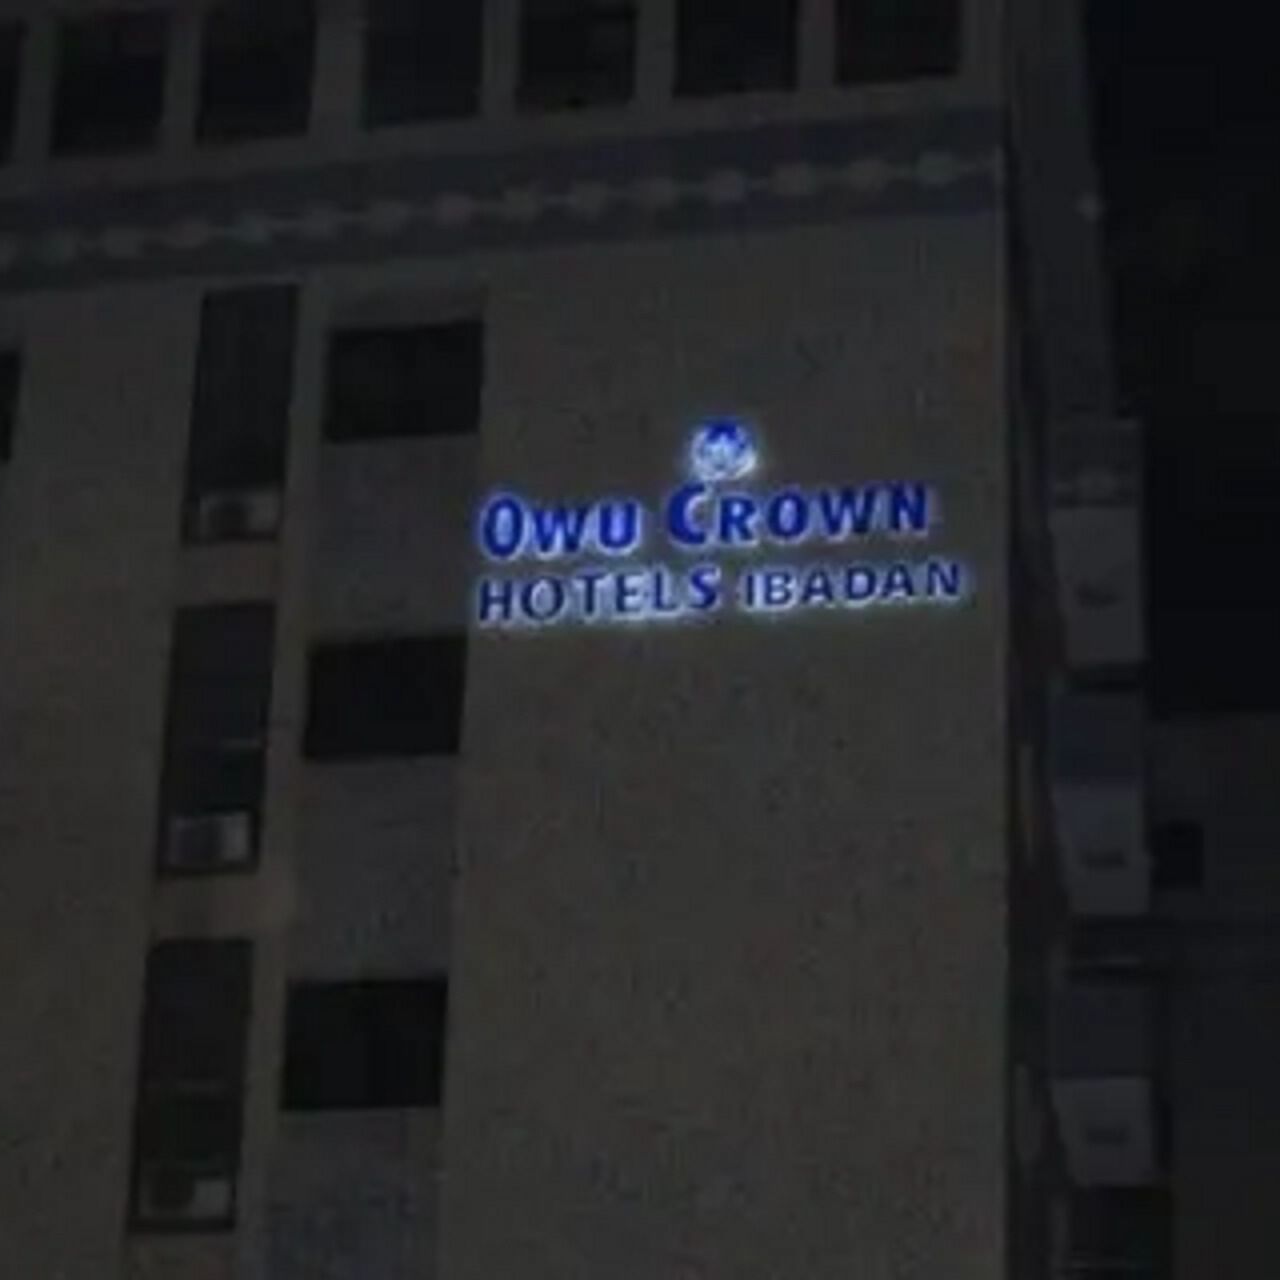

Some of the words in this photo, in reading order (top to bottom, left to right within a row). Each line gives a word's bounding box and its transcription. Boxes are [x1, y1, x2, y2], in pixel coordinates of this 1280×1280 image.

[480, 495, 639, 558] OWU
[666, 482, 928, 545] CROWN
[478, 566, 720, 622] HOTELS
[744, 561, 962, 607] IBADAN
